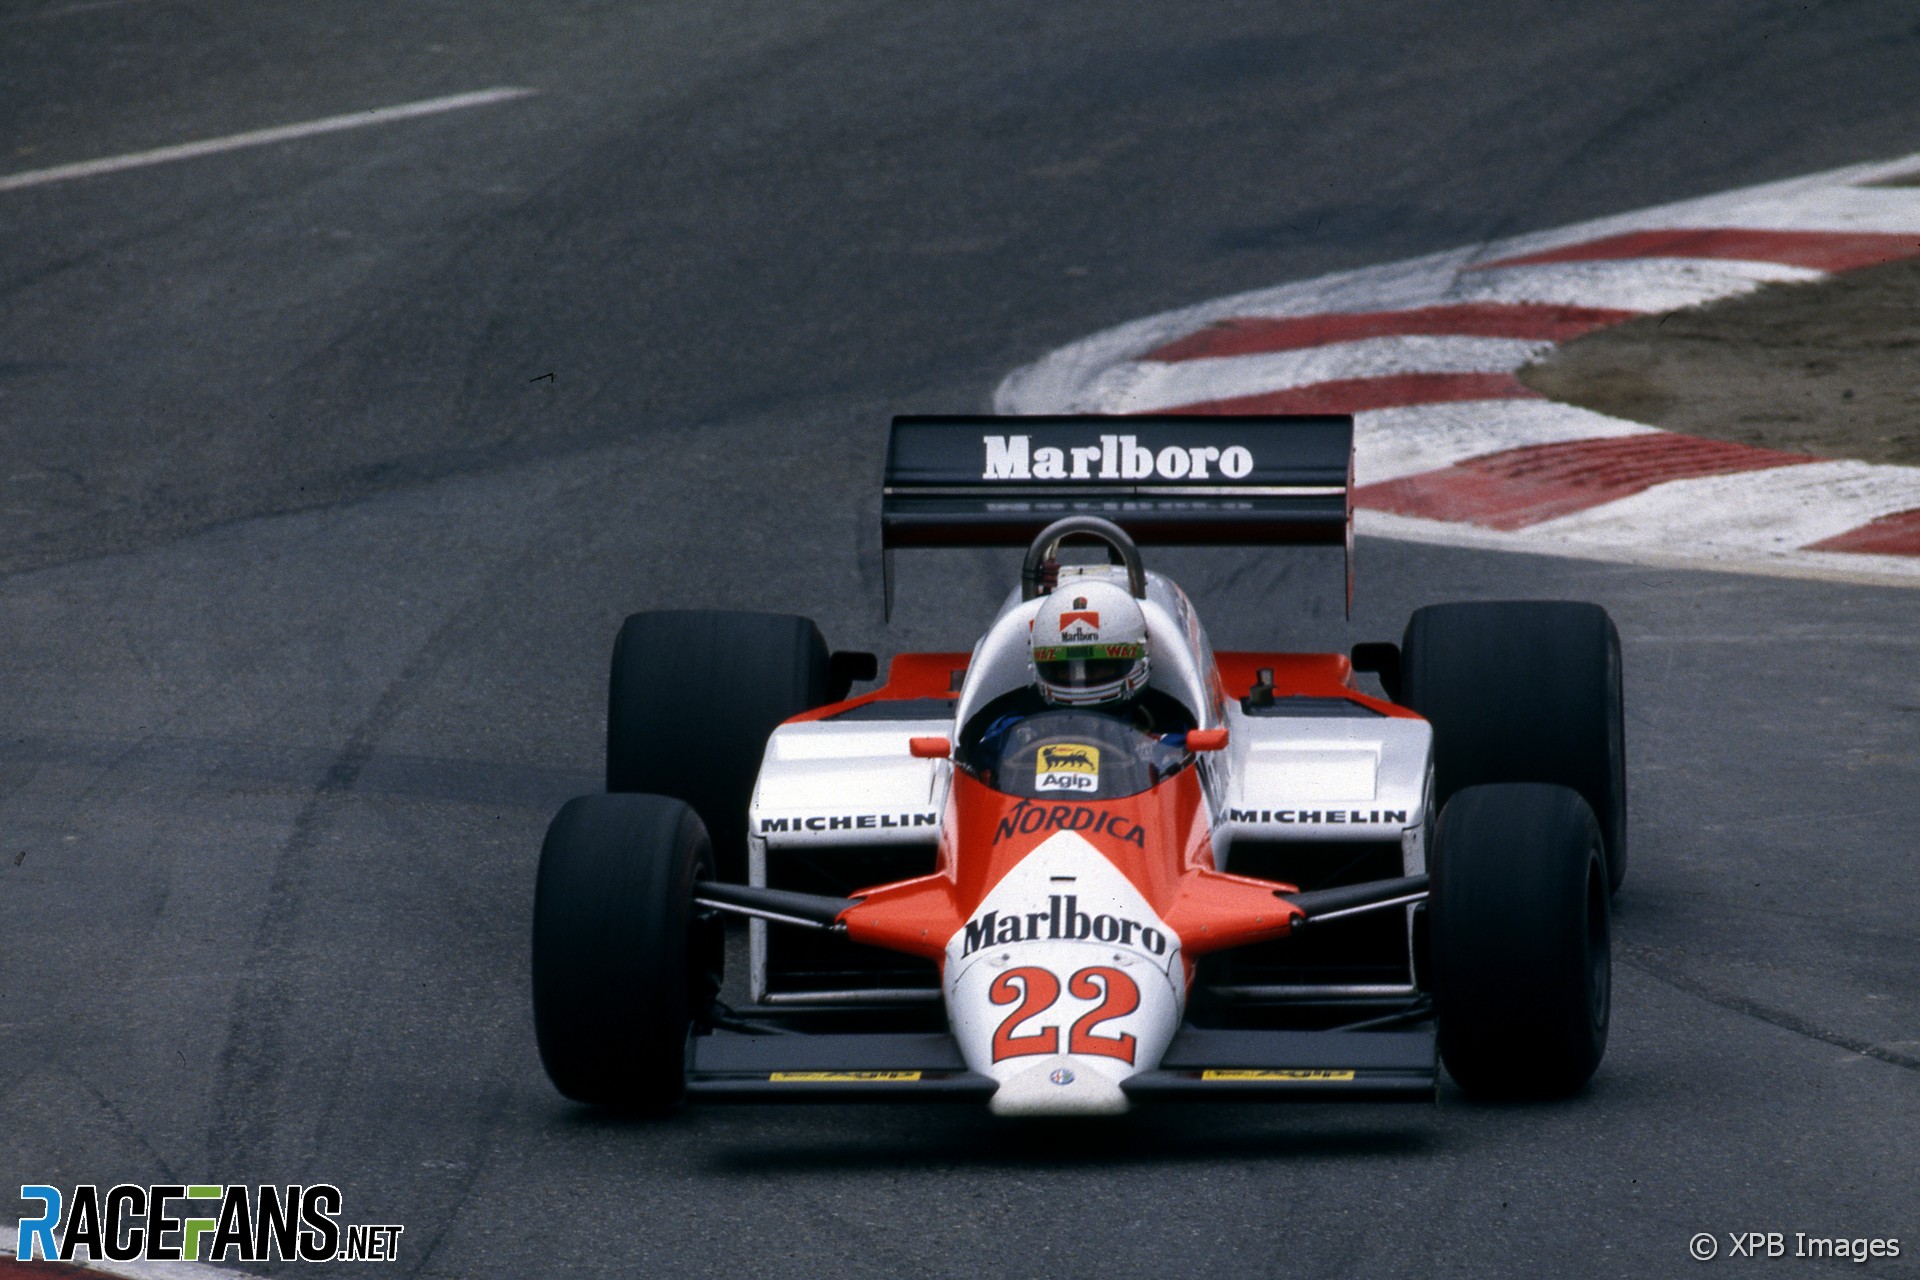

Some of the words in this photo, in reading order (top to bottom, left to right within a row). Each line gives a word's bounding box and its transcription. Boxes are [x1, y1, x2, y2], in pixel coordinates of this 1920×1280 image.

[982, 435, 1254, 480] Marlboro
[1062, 627, 1099, 642] Marlboro
[1042, 773, 1092, 788] Agip
[761, 812, 937, 833] MICHELIN
[992, 799, 1145, 848] NORDICA
[1230, 808, 1407, 823] MICHELIN
[961, 894, 1166, 960] Marlboro
[989, 966, 1141, 1067] 22
